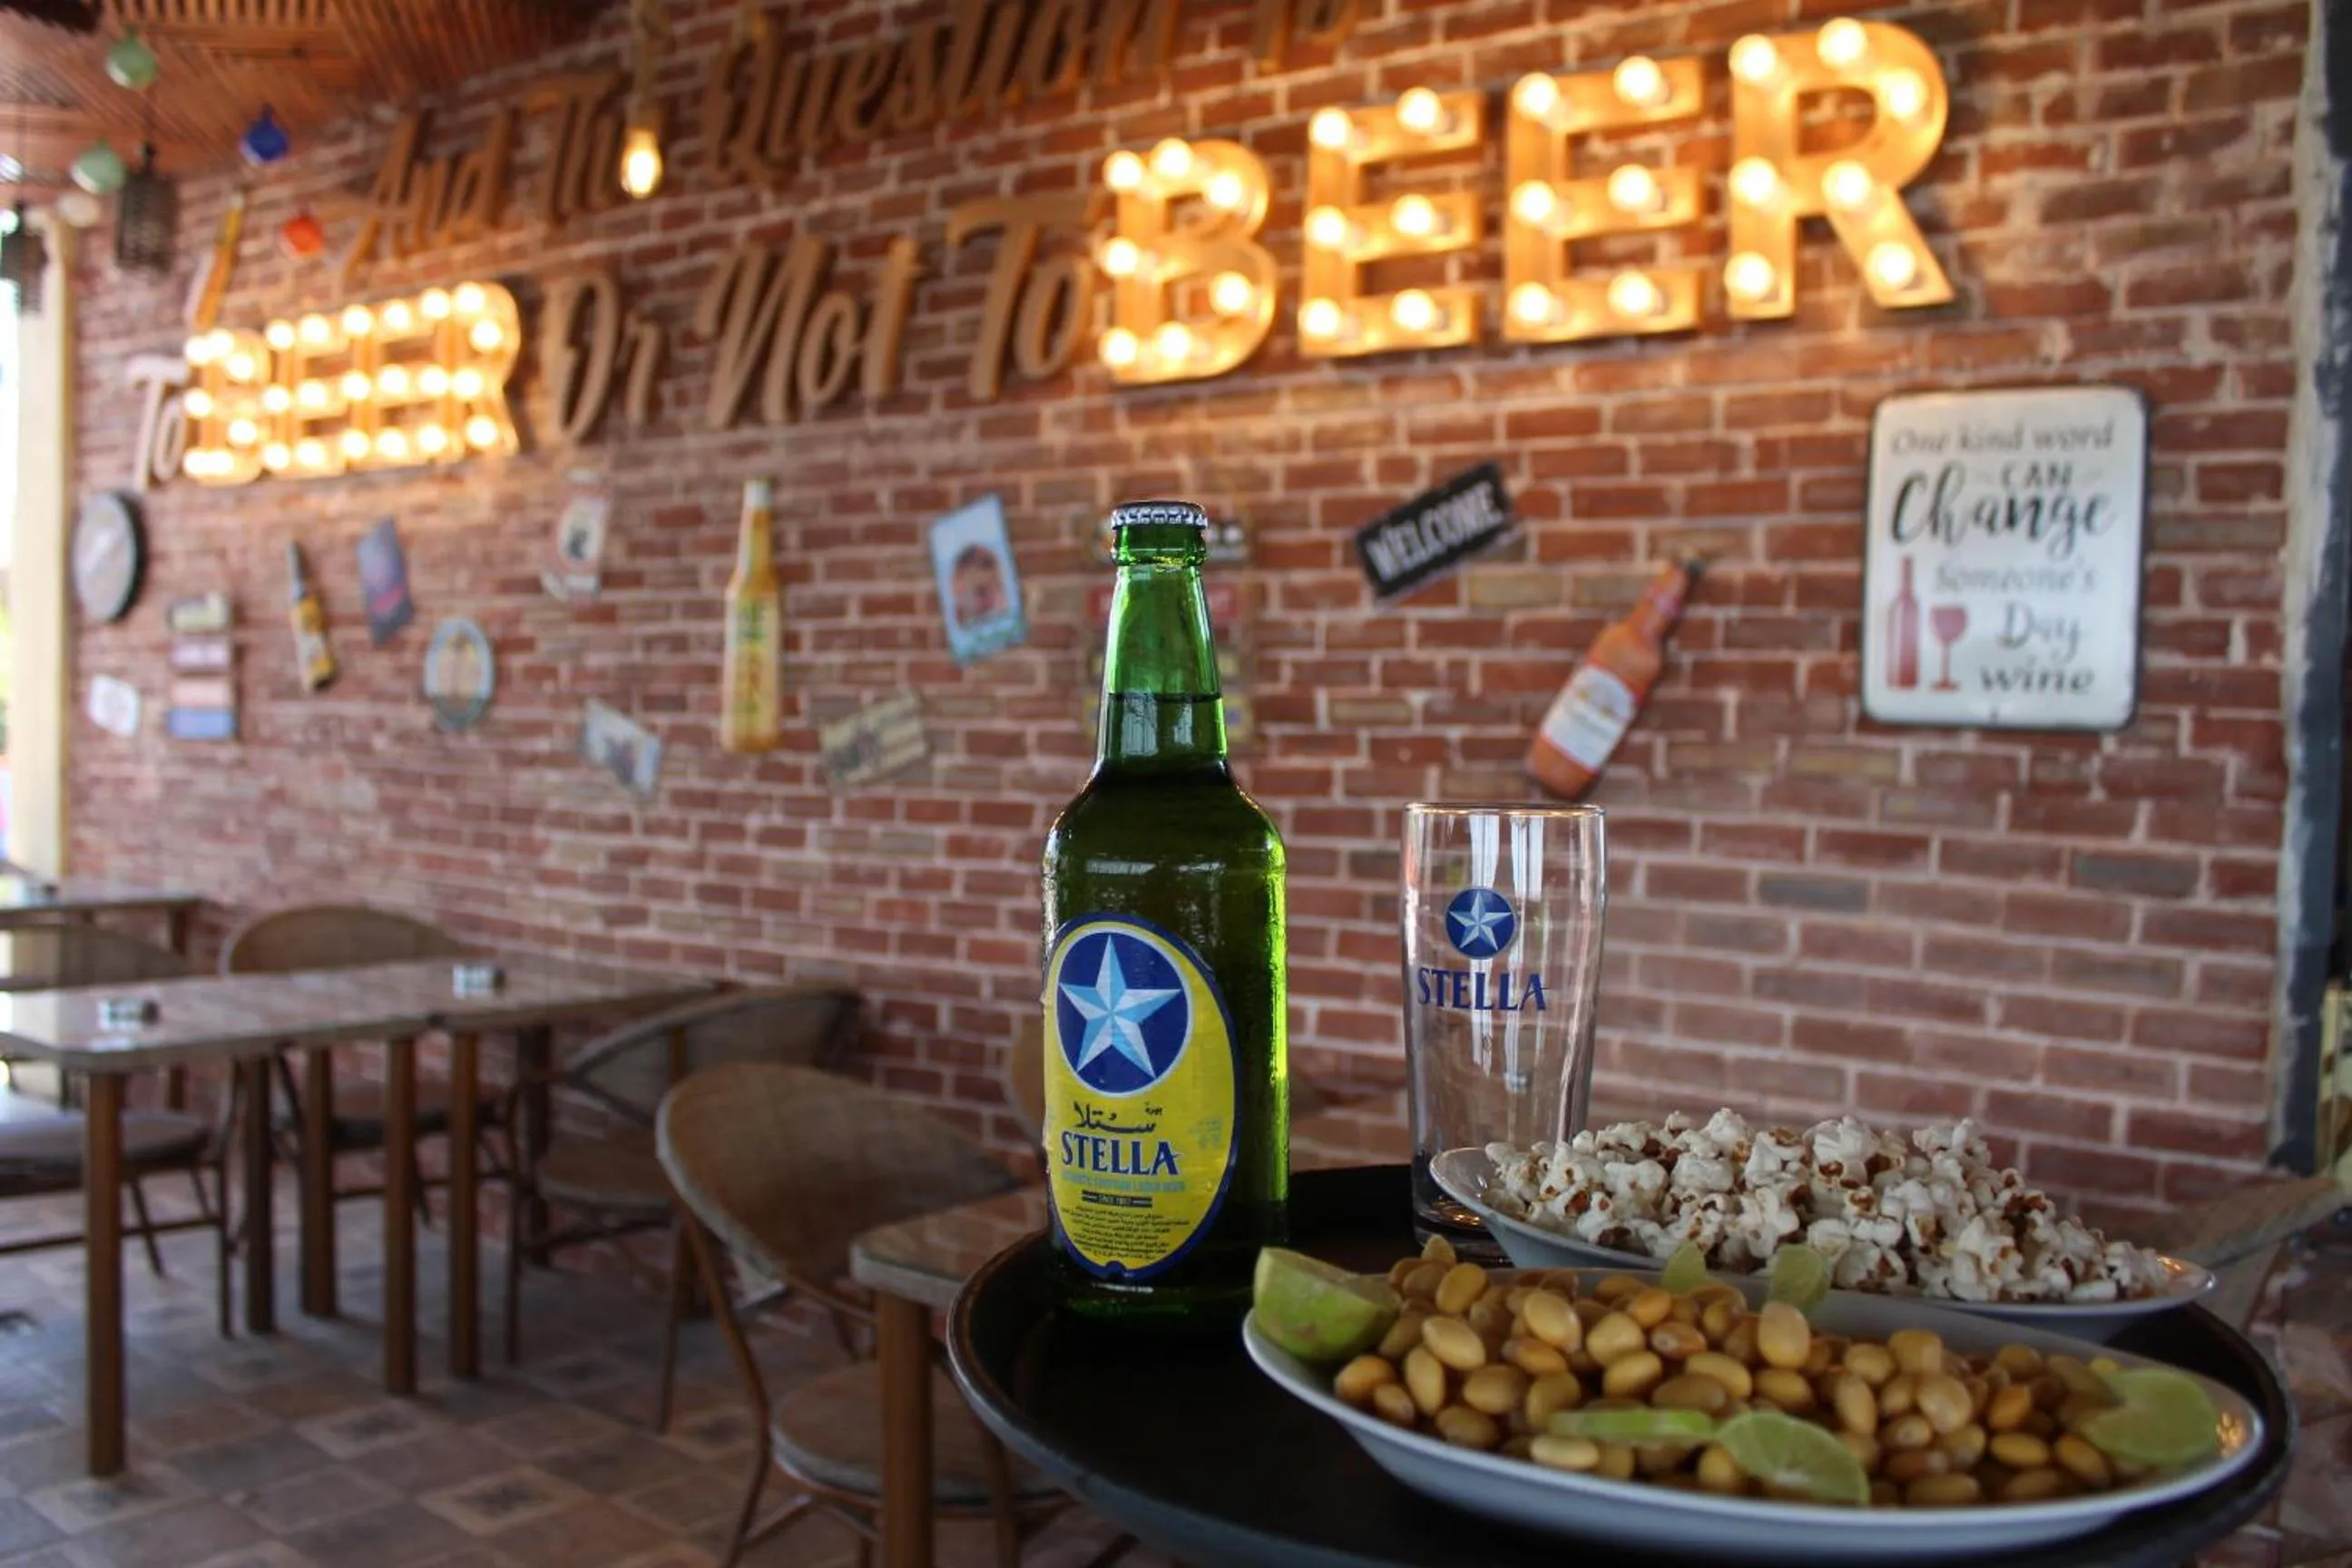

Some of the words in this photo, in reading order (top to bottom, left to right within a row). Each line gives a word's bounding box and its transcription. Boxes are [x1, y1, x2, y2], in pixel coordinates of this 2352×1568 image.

[125, 353, 188, 493] To
[184, 279, 520, 487] BEER
[540, 274, 661, 445] Or
[695, 230, 921, 429] Not
[946, 189, 1102, 403] To
[1099, 18, 1953, 385] BEER
[1890, 426, 1950, 456] One
[1957, 418, 2024, 453] kind
[2033, 416, 2116, 451] word
[2000, 460, 2074, 488] CAN
[1364, 480, 1506, 583] WELCOME
[1889, 458, 2117, 561] Change
[1994, 601, 2084, 663] Day
[1979, 652, 2096, 694] wine
[1416, 965, 1551, 1011] STELLA
[1061, 1130, 1182, 1176] STELLA
